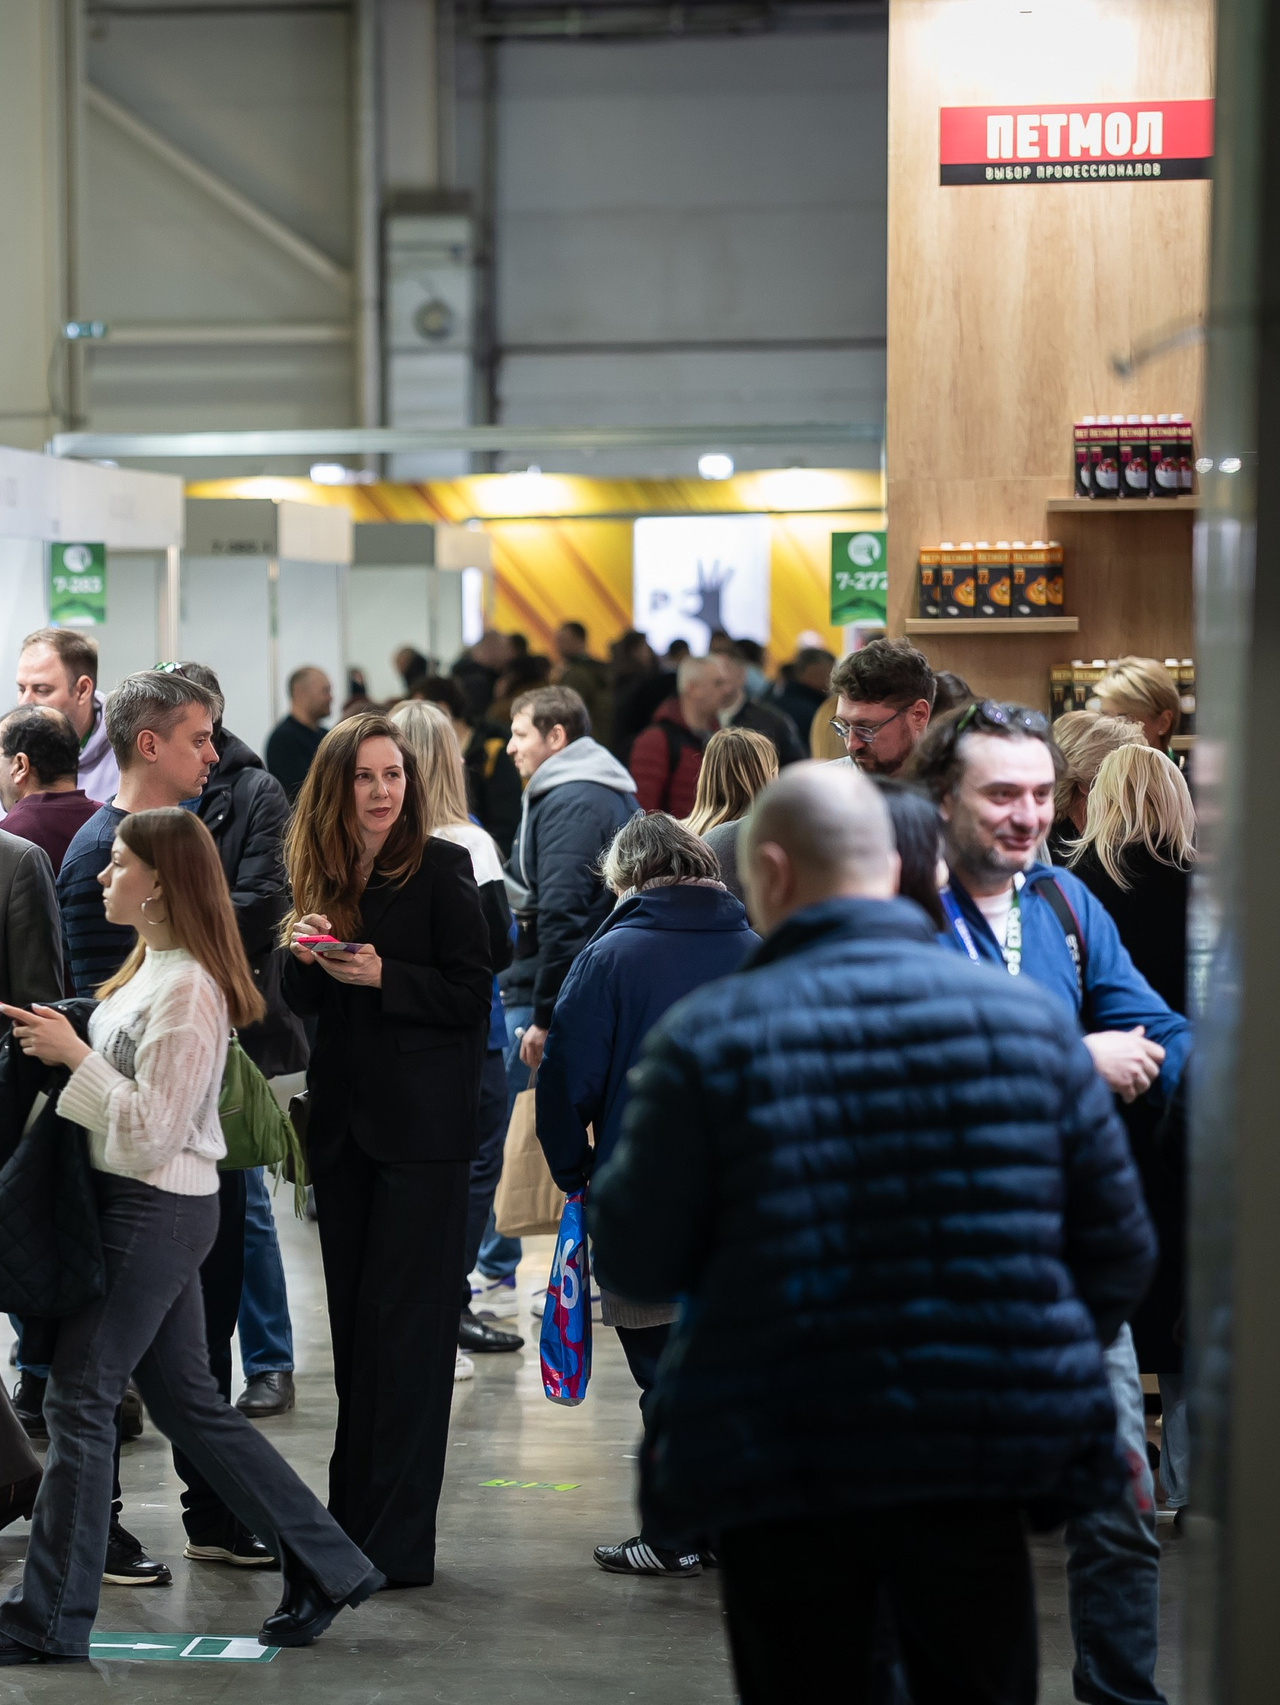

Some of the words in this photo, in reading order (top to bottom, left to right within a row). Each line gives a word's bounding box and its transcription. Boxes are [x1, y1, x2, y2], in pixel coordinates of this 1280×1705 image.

[986, 111, 1163, 159] ПЕТМОЛ
[985, 165, 1031, 181] ВЫБОР
[1036, 162, 1162, 179] ПРОФЕССИОНАЛОВ
[835, 571, 888, 590] 7-272
